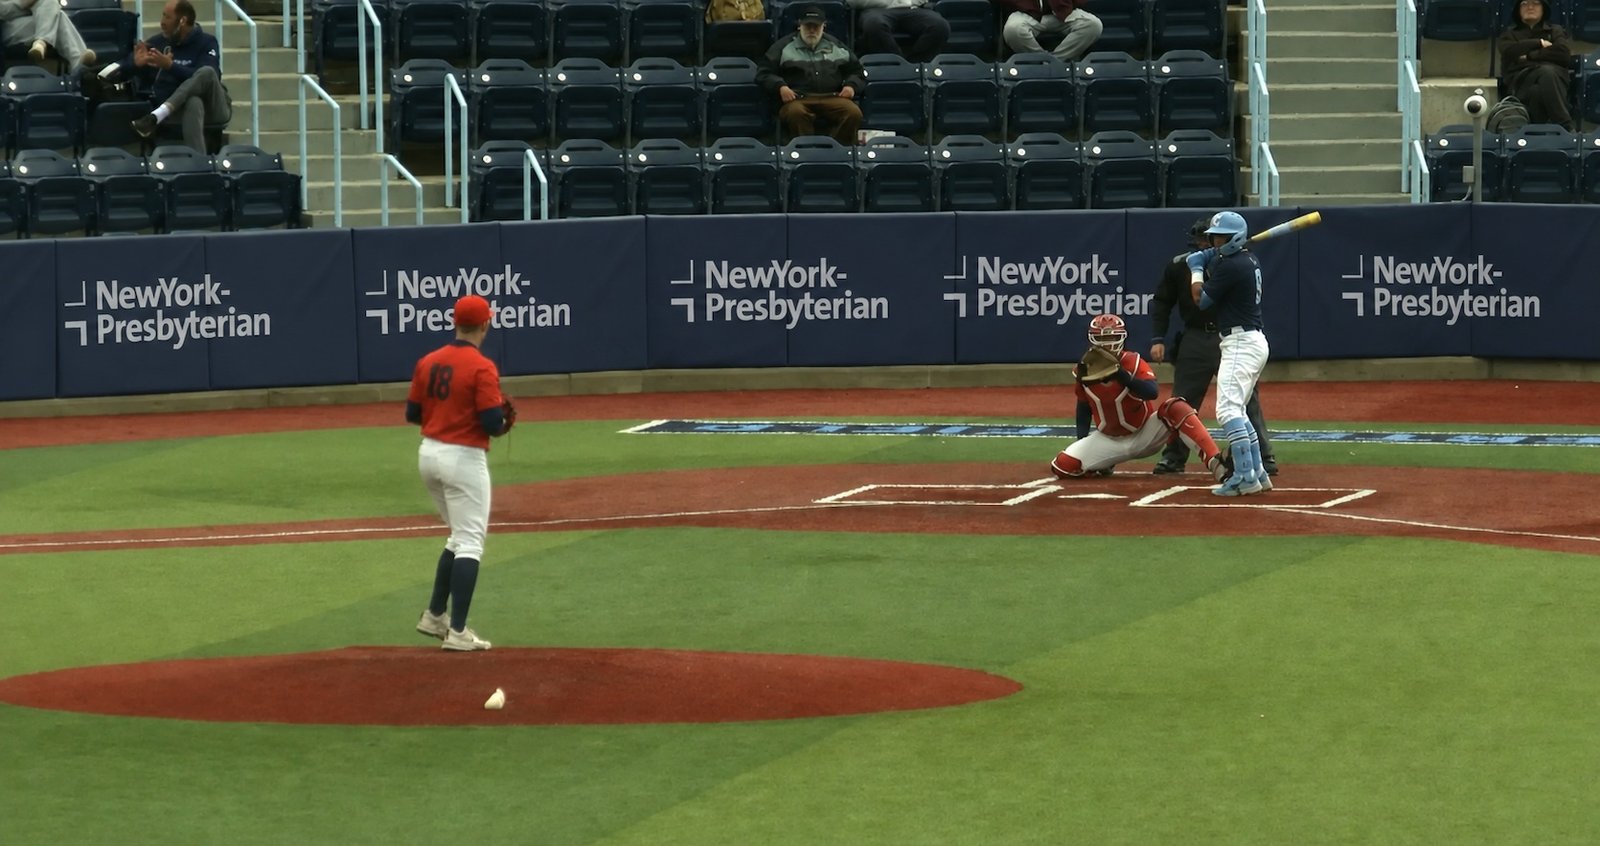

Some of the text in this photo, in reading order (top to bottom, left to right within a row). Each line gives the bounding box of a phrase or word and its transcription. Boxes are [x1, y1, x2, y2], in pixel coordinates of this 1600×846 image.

[397, 264, 531, 299] NewYork-
[706, 257, 847, 288] NewYork-
[977, 254, 1119, 284] NewYork-
[1373, 255, 1502, 284] NewYork-
[97, 273, 231, 310] NewYork-
[707, 289, 889, 329] Presbyterian
[1374, 286, 1540, 325] Presbyterian
[97, 306, 271, 349] Presbyterian
[399, 296, 571, 332] Presterian
[426, 362, 454, 401] 18
